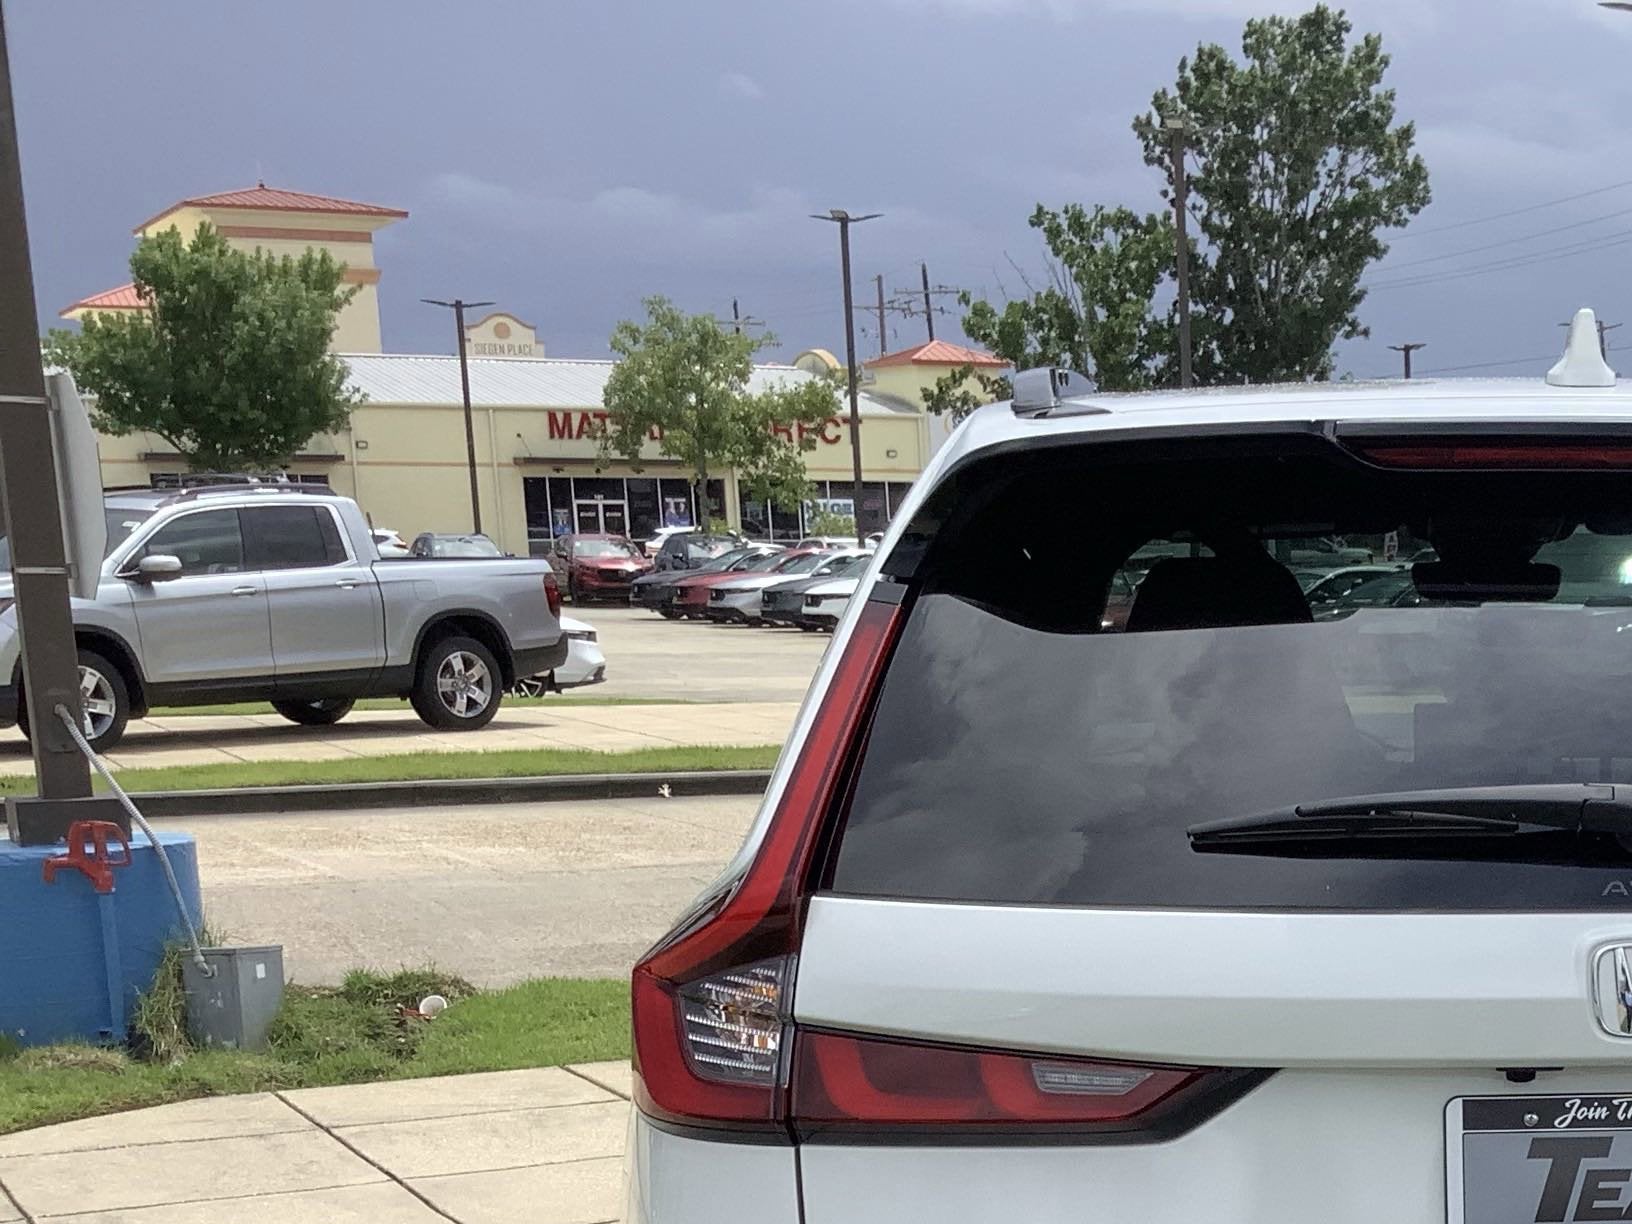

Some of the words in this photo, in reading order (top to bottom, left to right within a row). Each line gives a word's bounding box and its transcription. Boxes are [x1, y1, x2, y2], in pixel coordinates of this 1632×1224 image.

[474, 343, 505, 355] SIEGEN
[507, 343, 533, 356] PLACE
[1554, 1099, 1610, 1128] Join
